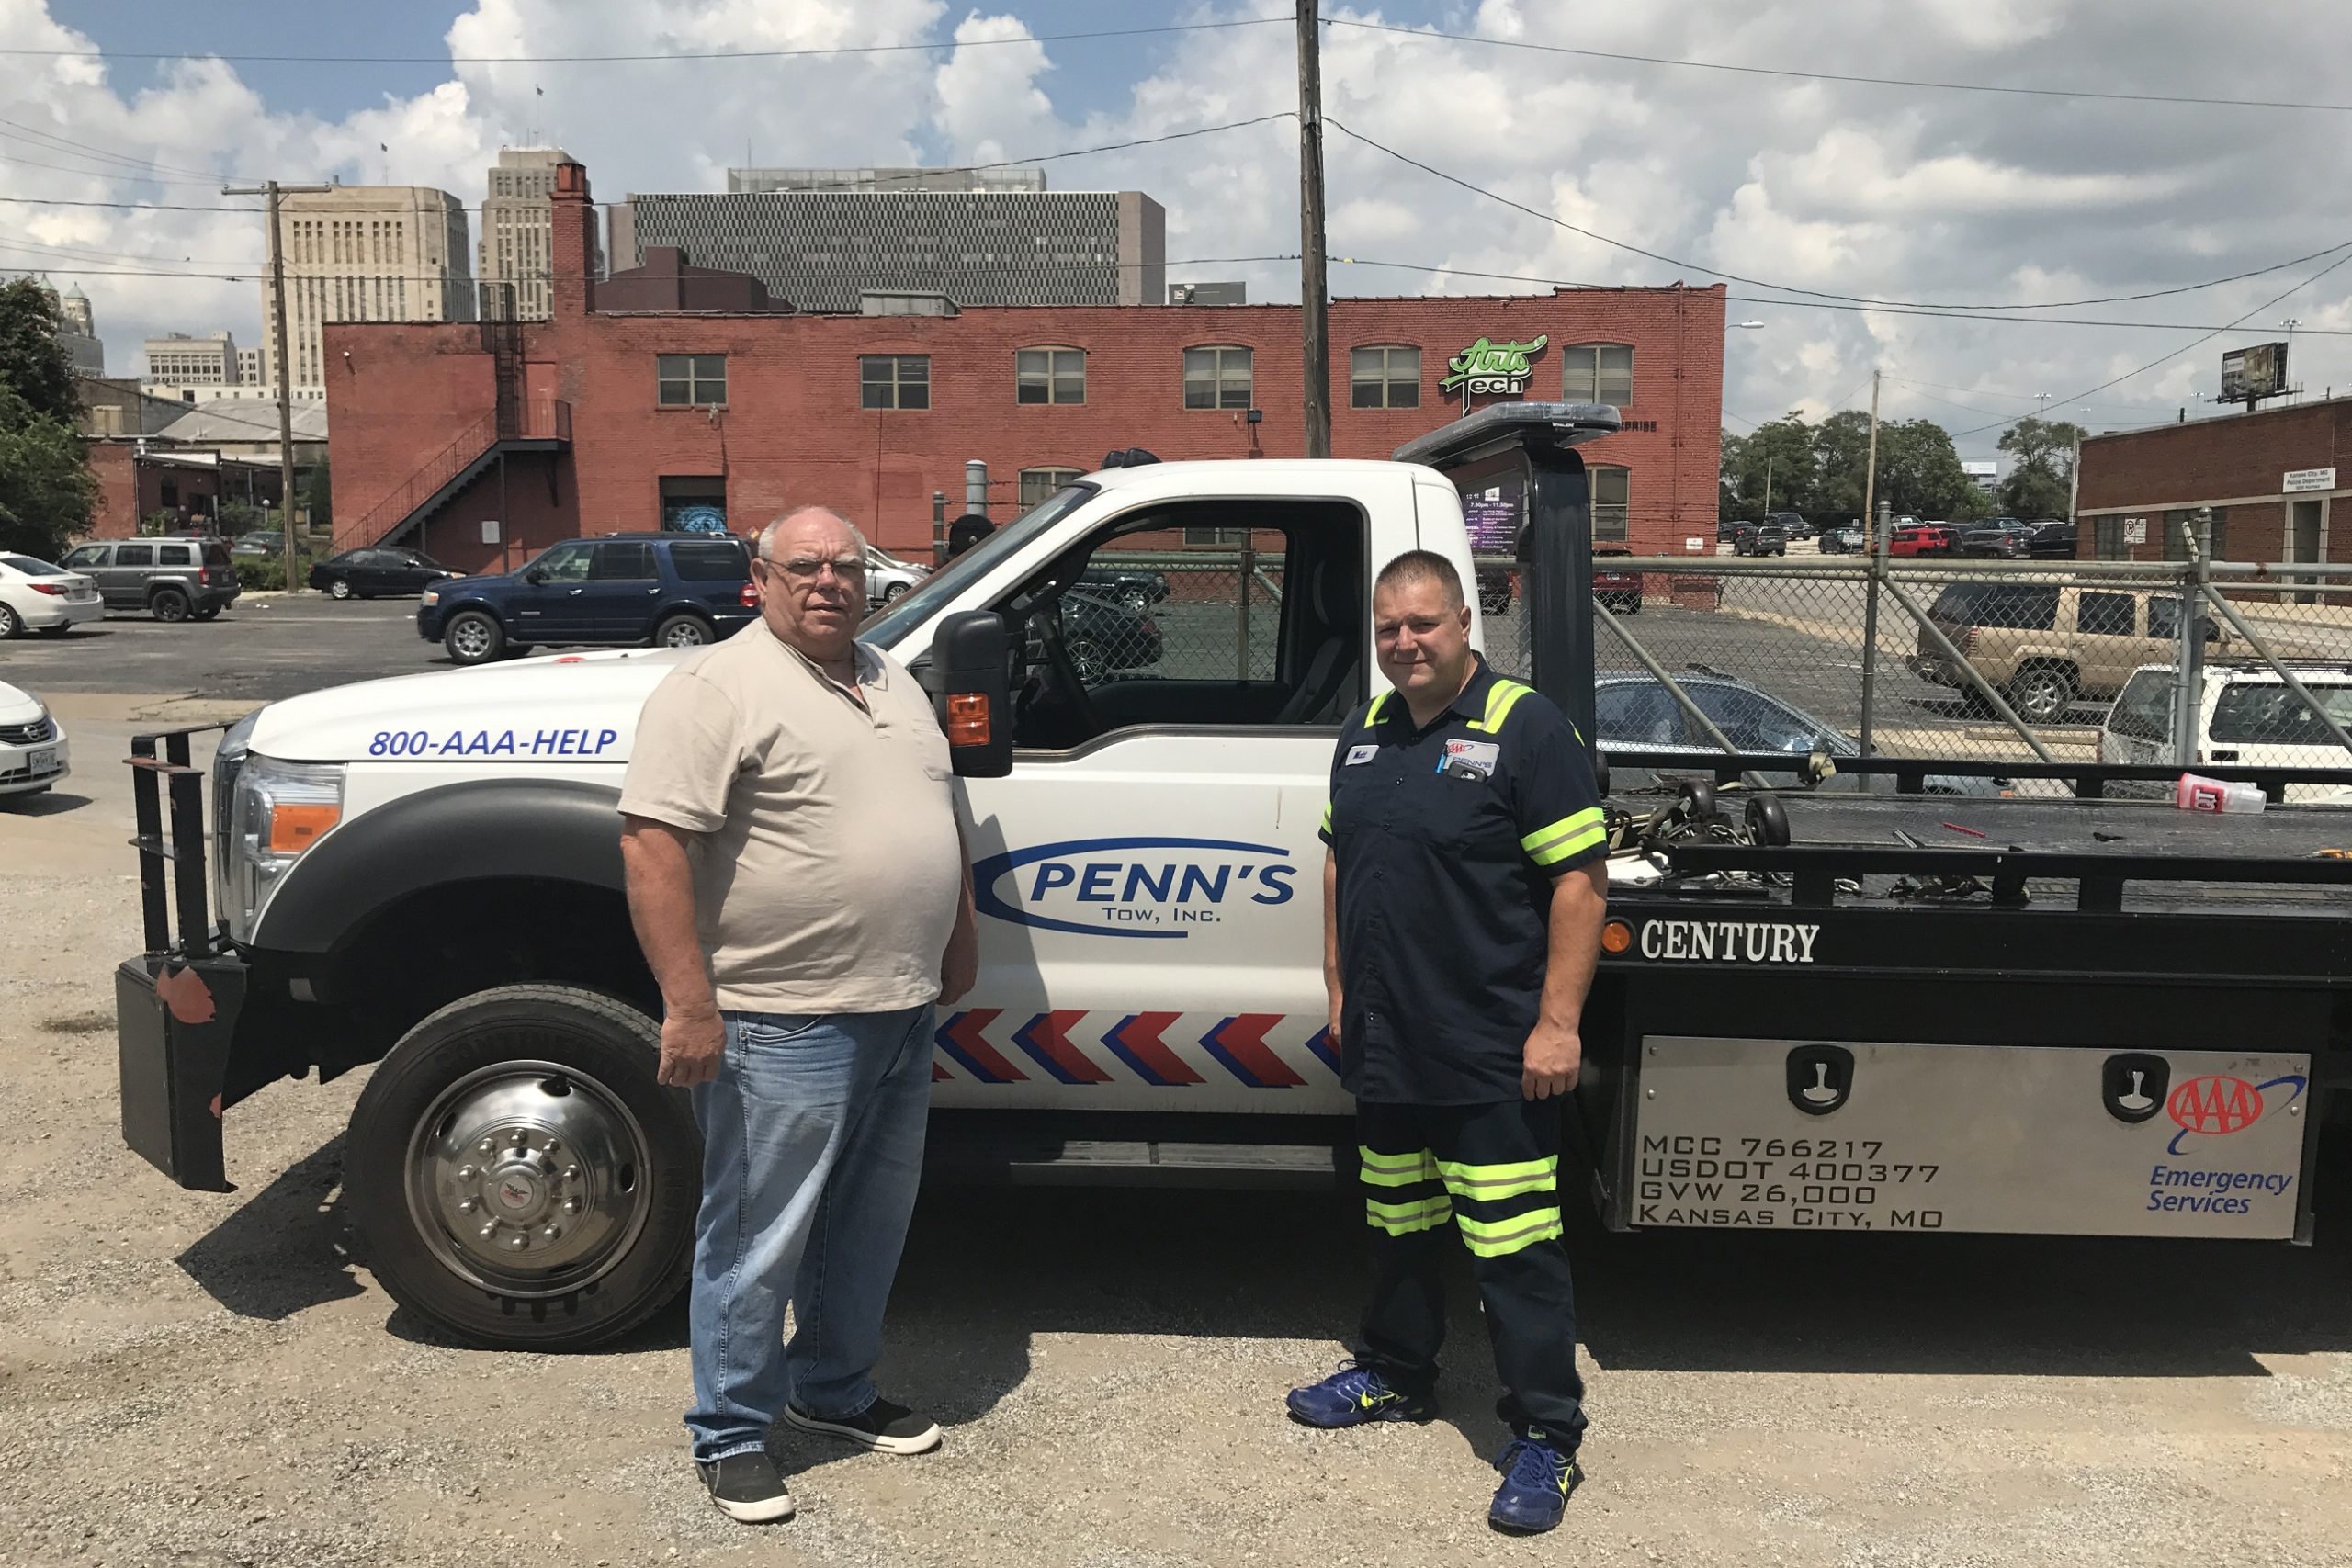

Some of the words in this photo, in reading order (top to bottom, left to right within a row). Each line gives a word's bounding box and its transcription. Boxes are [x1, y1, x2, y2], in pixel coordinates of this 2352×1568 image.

[1449, 334, 1547, 371] Arts
[1622, 421, 1657, 432] PRISE
[368, 729, 617, 756] 800-AAA-HELP
[1449, 744, 1464, 753] AAA
[1453, 756, 1492, 768] PENN'S
[1030, 863, 1298, 905] PENN'S
[1641, 919, 1820, 963] CENTURY
[2175, 1076, 2256, 1134] AAA
[1643, 1135, 1721, 1156] MCC
[1741, 1139, 1883, 1159] 766217
[1643, 1159, 1773, 1179] USDOT
[1788, 1162, 1939, 1183] 400377
[2150, 1165, 2292, 1195] Emergency
[1641, 1182, 1724, 1201] GVW
[1740, 1184, 1876, 1206] 26,000
[2147, 1190, 2251, 1214] Services
[1639, 1204, 1774, 1225] KANSAS
[1793, 1209, 1871, 1229] CITY,
[1890, 1210, 1943, 1228] MO
